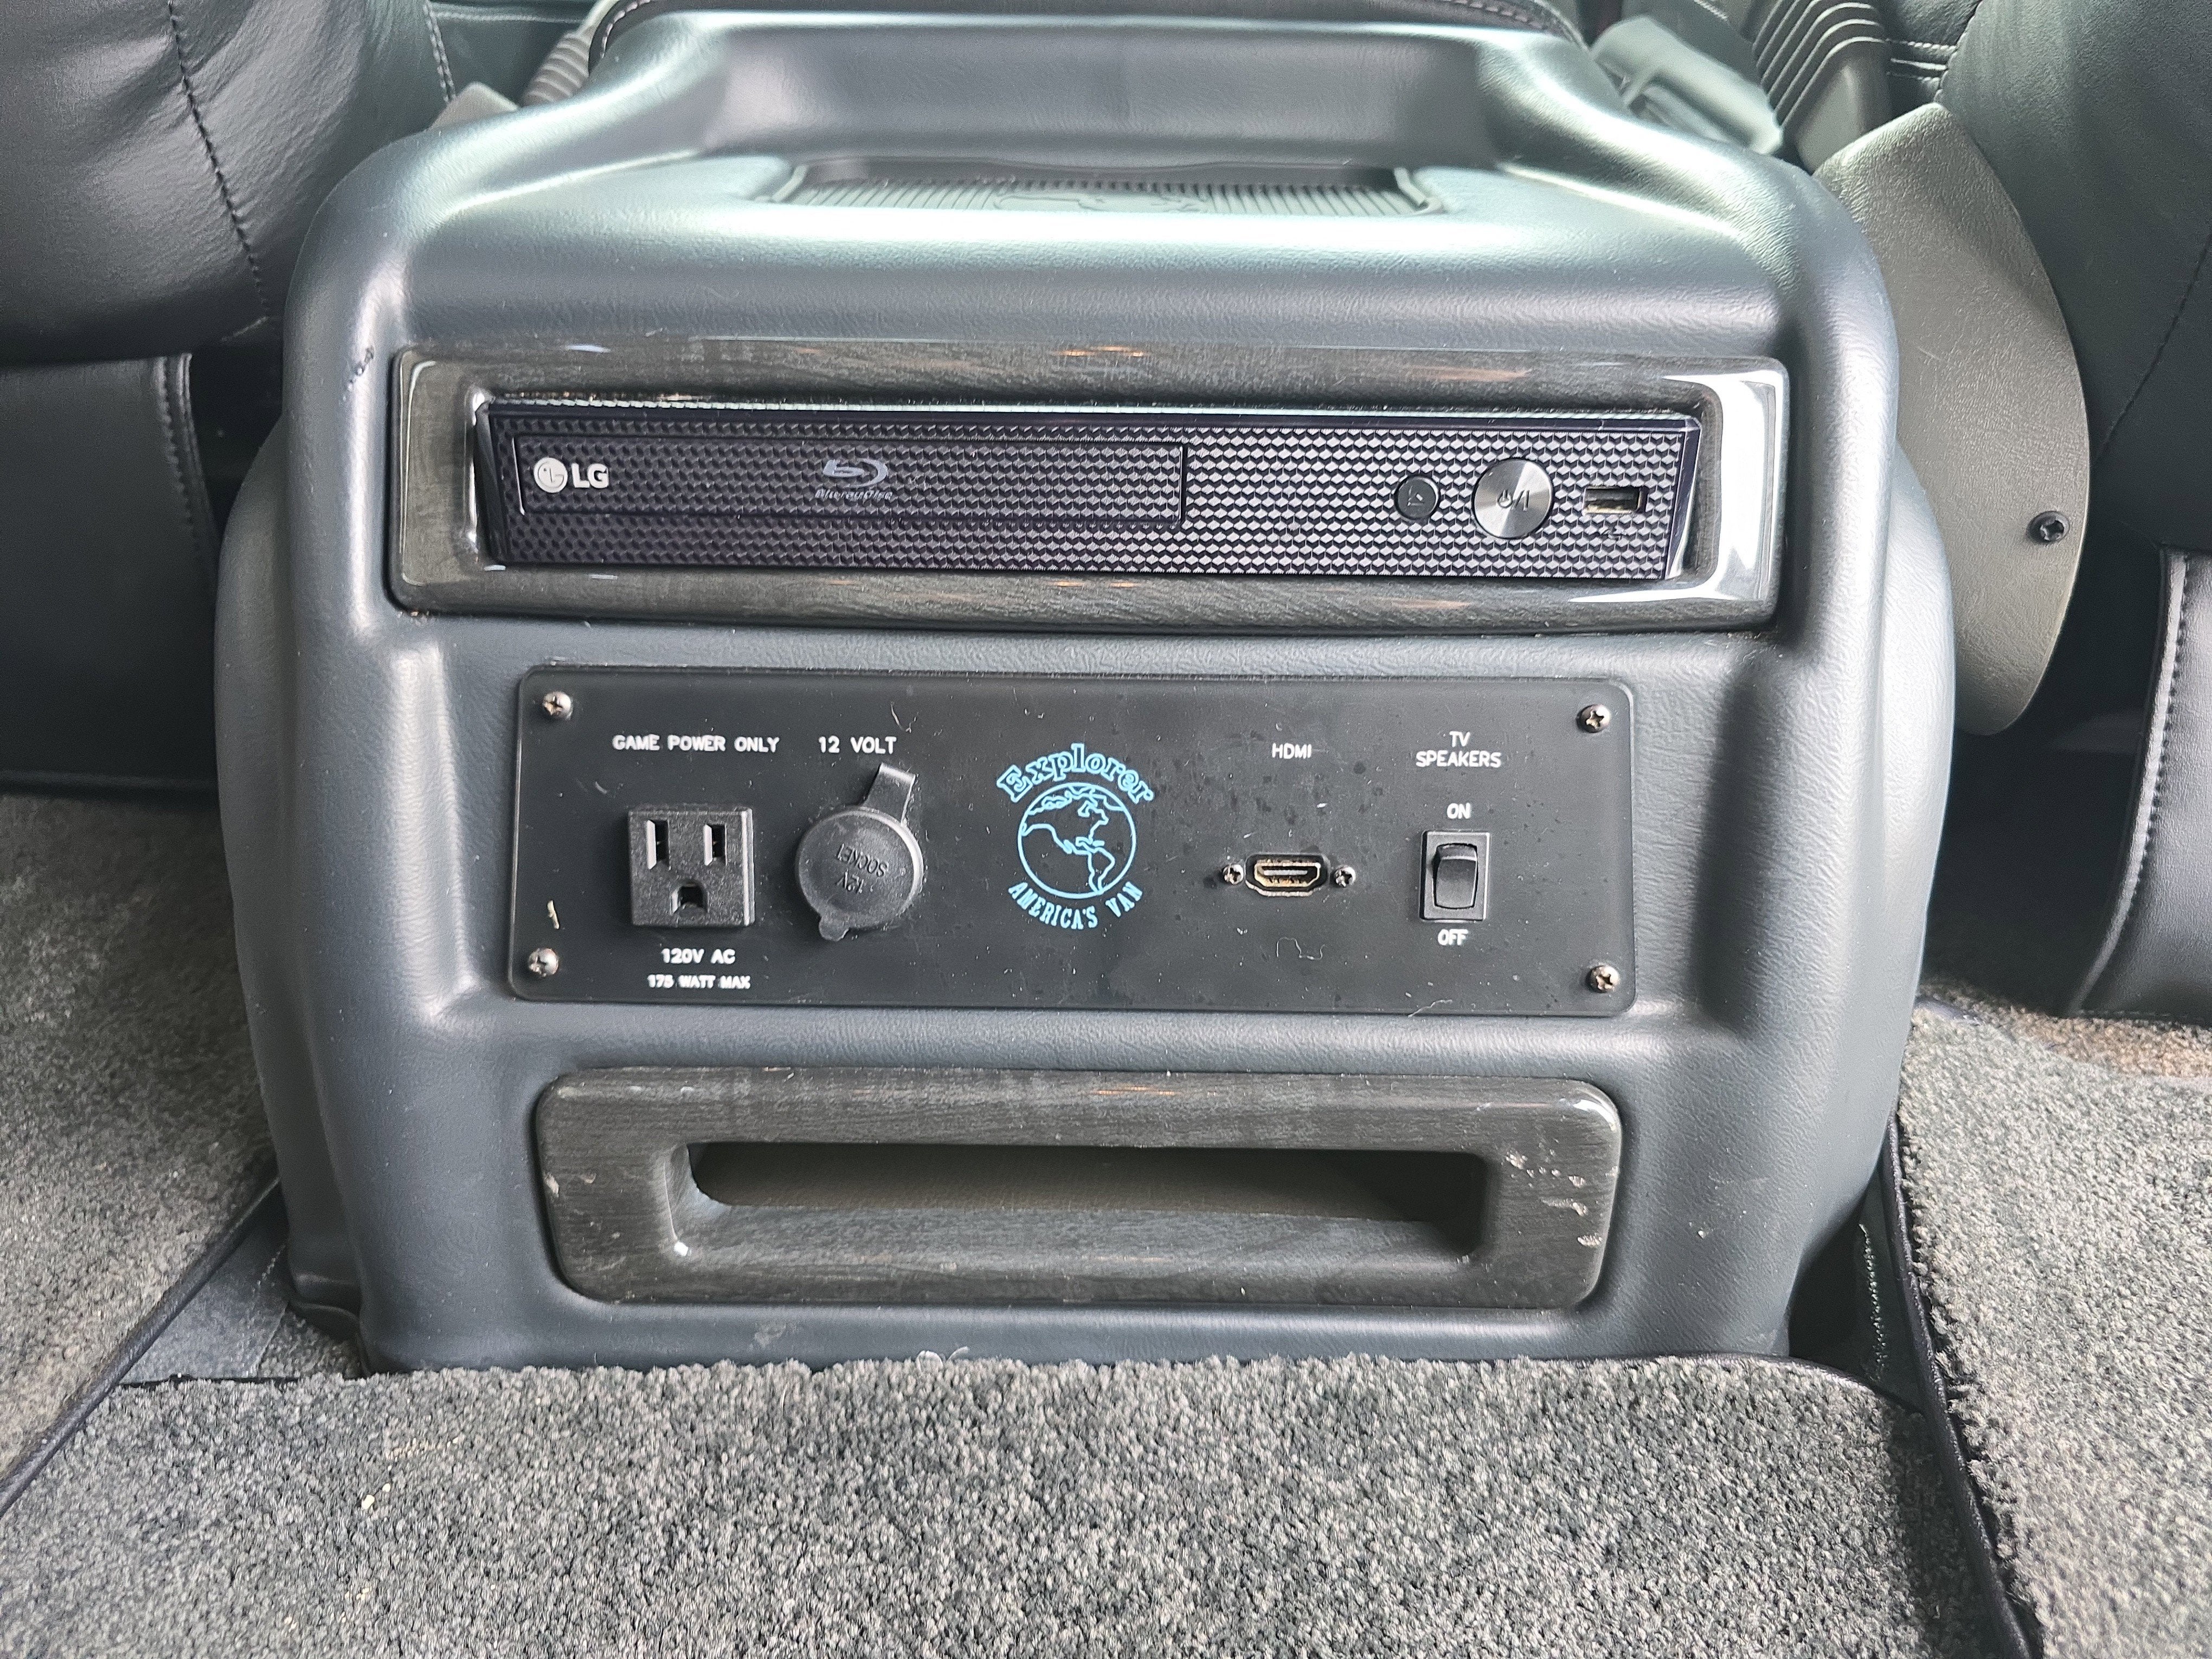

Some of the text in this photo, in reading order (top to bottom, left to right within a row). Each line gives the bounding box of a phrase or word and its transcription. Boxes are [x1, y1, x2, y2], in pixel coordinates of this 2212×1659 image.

[571, 462, 609, 489] LG
[612, 734, 780, 753] GAME POWER ONLY
[818, 735, 897, 755] 12 VOLT
[1449, 731, 1470, 748] TV
[1271, 742, 1312, 760] HDMI
[1415, 750, 1502, 768] SPEAKERS
[996, 743, 1155, 804] Explorer
[1446, 802, 1471, 820] ON
[836, 843, 889, 878] SOCKET
[1007, 880, 1143, 930] AMERICA'S VAN
[1437, 928, 1470, 947] OFF
[661, 948, 736, 965] 120V AC
[678, 975, 716, 989] WATT
[719, 975, 751, 989] MAX
